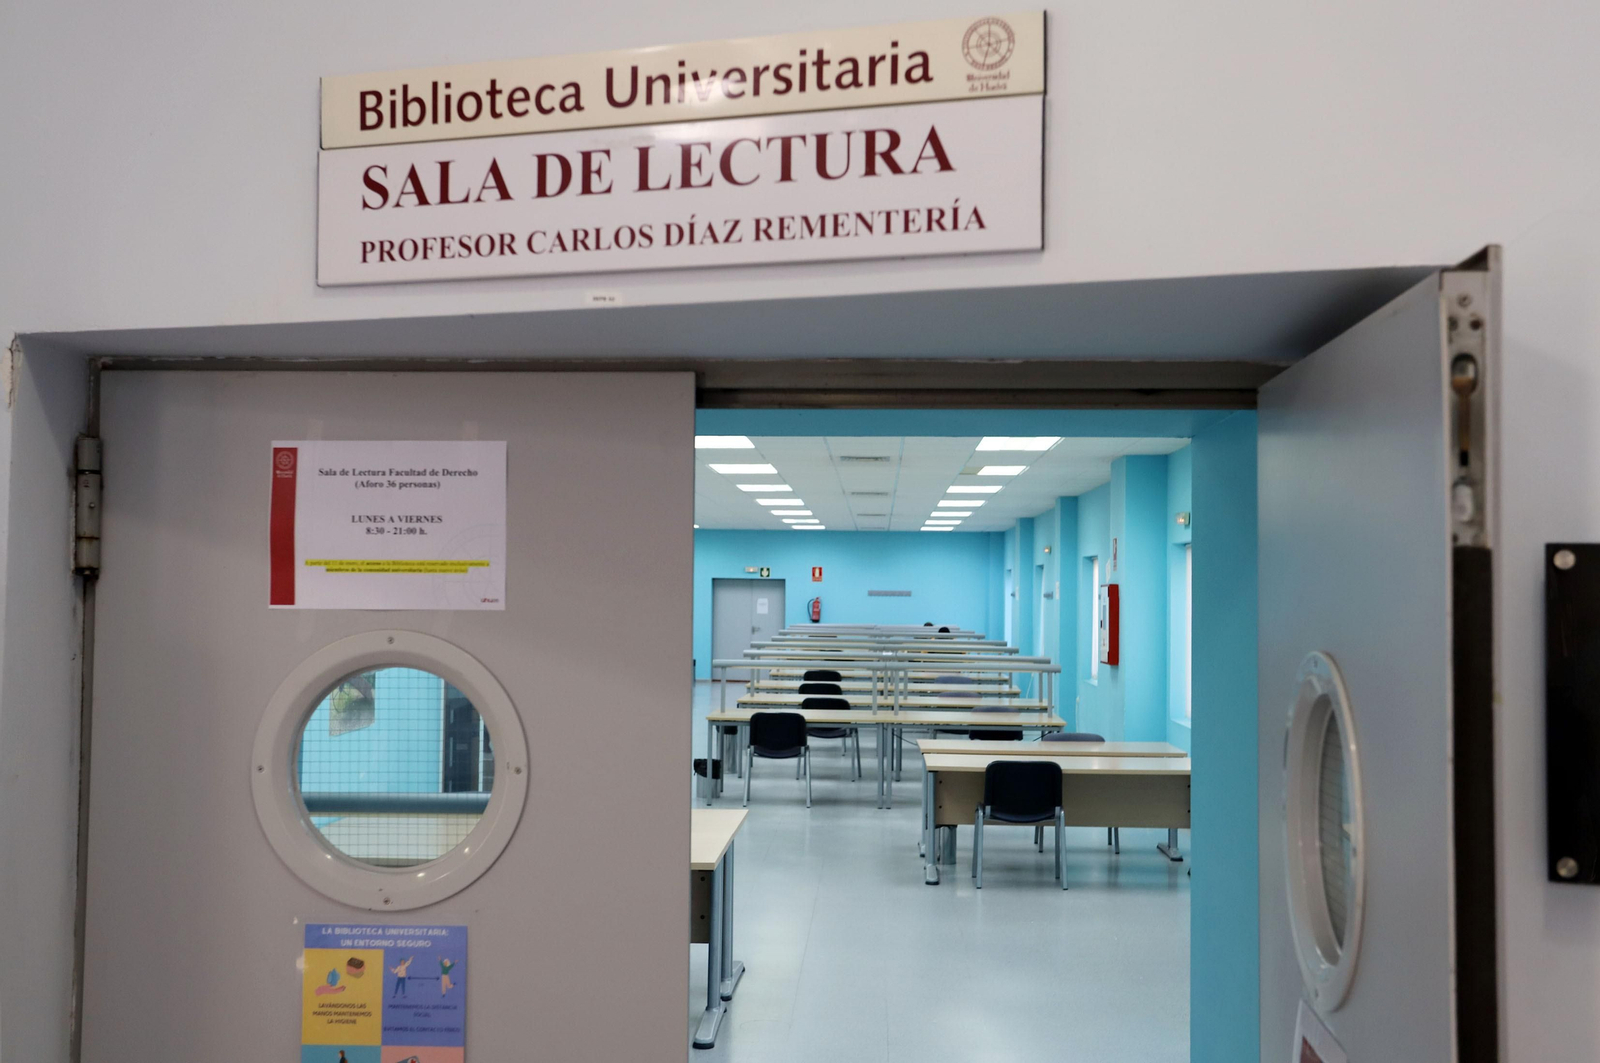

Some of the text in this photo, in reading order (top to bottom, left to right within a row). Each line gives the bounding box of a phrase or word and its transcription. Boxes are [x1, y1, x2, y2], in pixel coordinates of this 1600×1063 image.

[359, 78, 585, 132] Biblioteca
[605, 40, 934, 109] Universitaria
[361, 124, 957, 211] SALA DE LECTURA
[360, 197, 987, 264] PROFESOR CARLOS DÍAZ REMENTERÍA
[318, 468, 478, 477] Sala de Lectura Facultad de Derecho
[354, 480, 441, 490] (Aforo 36 personas)
[351, 515, 443, 523] LUNES A VIERNES
[365, 527, 385, 535] 8:30
[393, 527, 417, 535] 21:00
[419, 527, 428, 535] h.
[321, 927, 449, 936] LA BIBLIOTECA UNIVERSITARIA:
[341, 939, 432, 948] UN ENTORNO SEGURO
